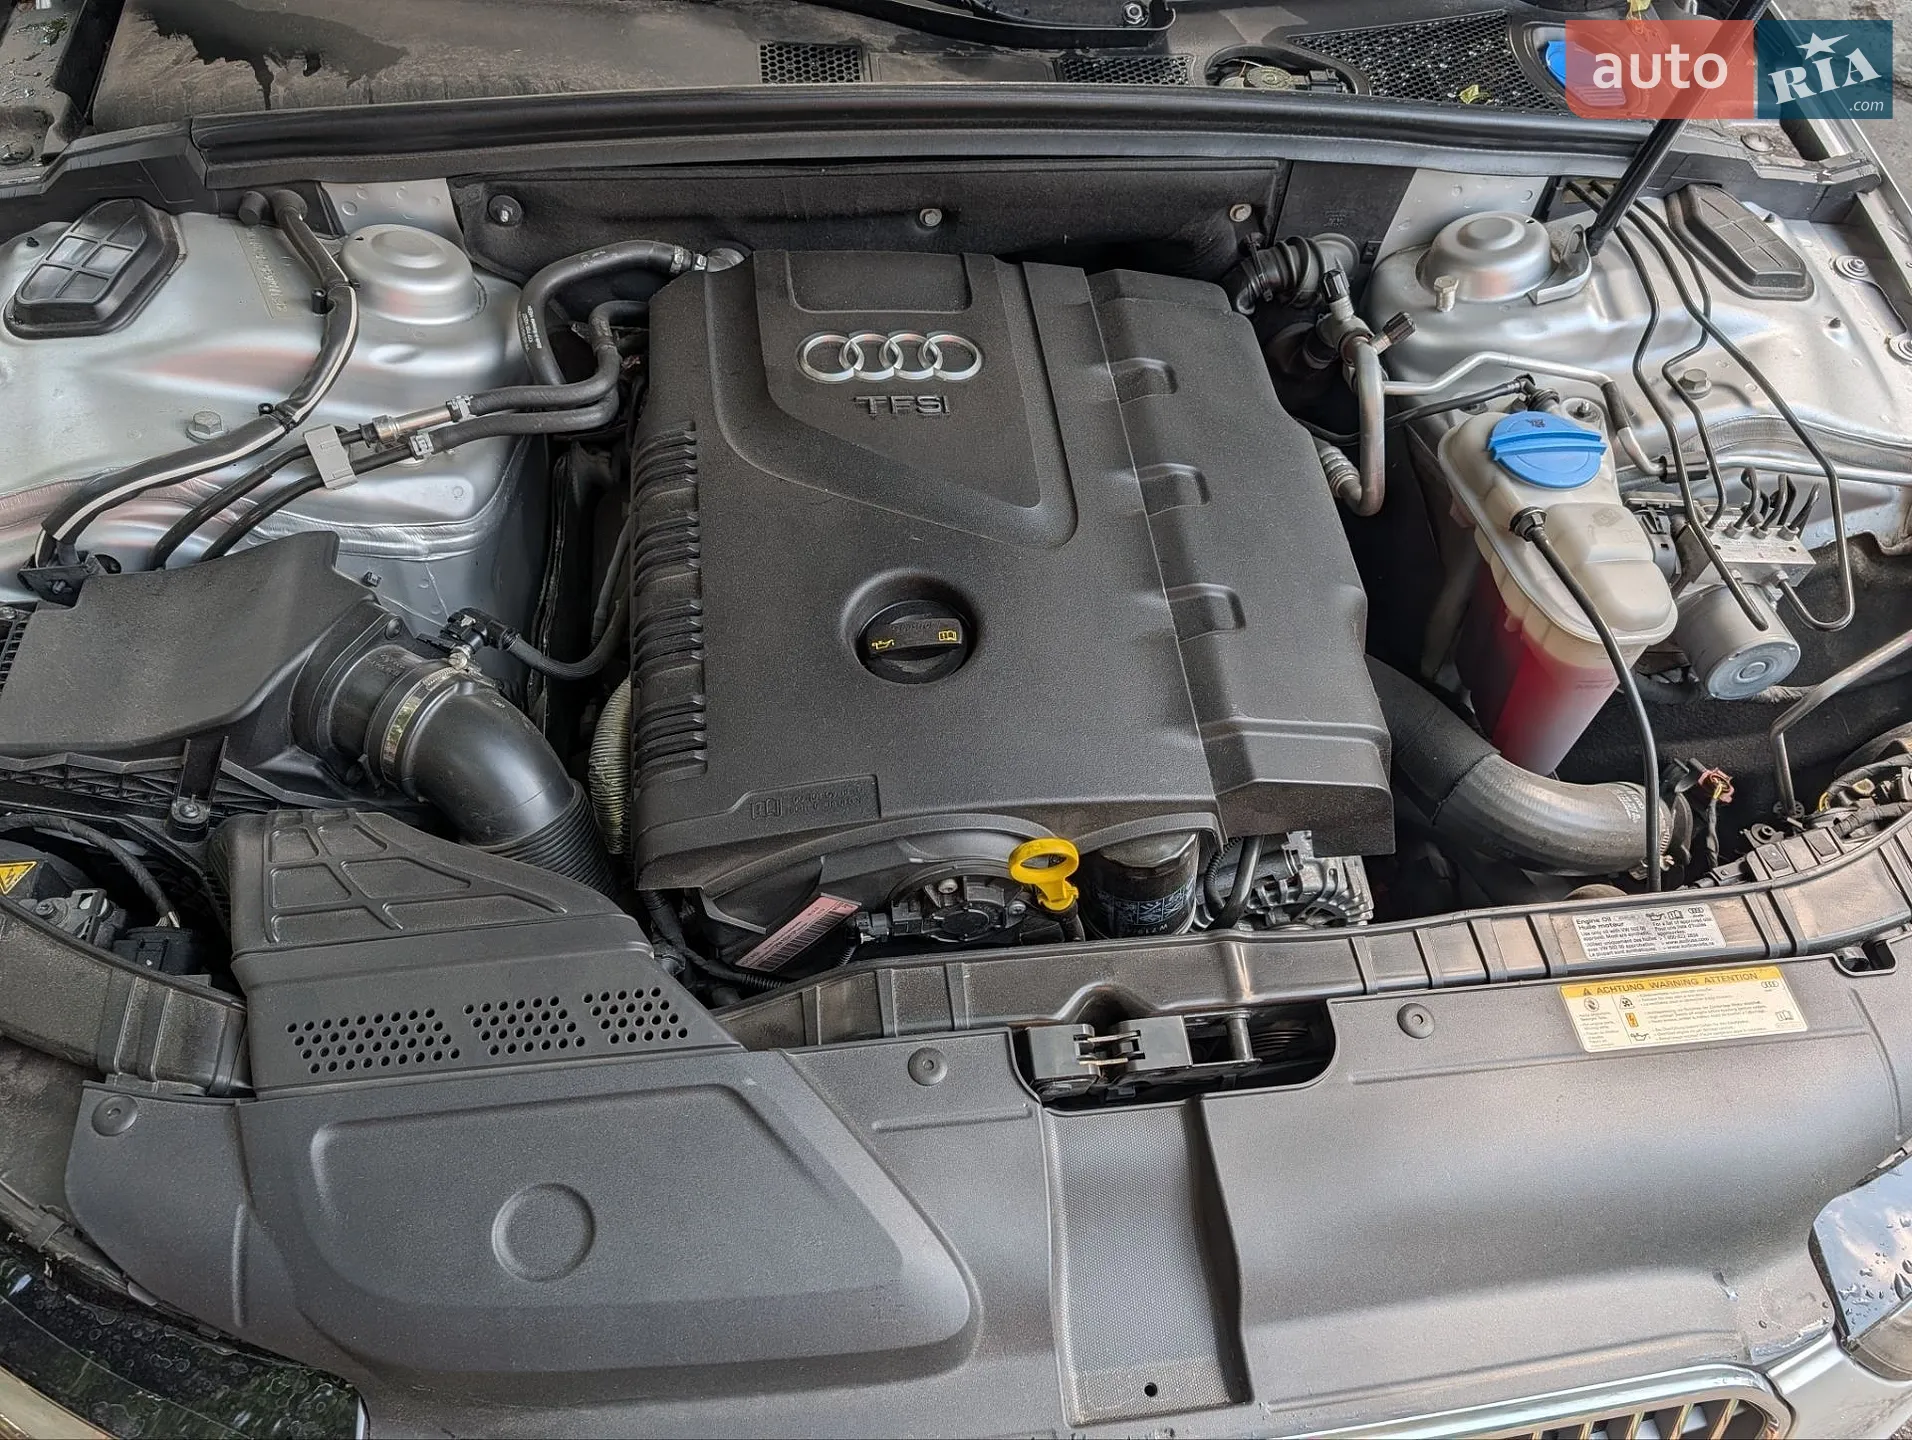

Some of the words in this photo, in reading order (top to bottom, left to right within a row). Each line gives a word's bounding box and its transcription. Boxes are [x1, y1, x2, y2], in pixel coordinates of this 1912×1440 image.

[853, 395, 951, 416] TFSI
[1596, 983, 1645, 994] ACHTUNG
[1649, 978, 1699, 989] WARNING
[1704, 973, 1759, 984] ATTENTION
